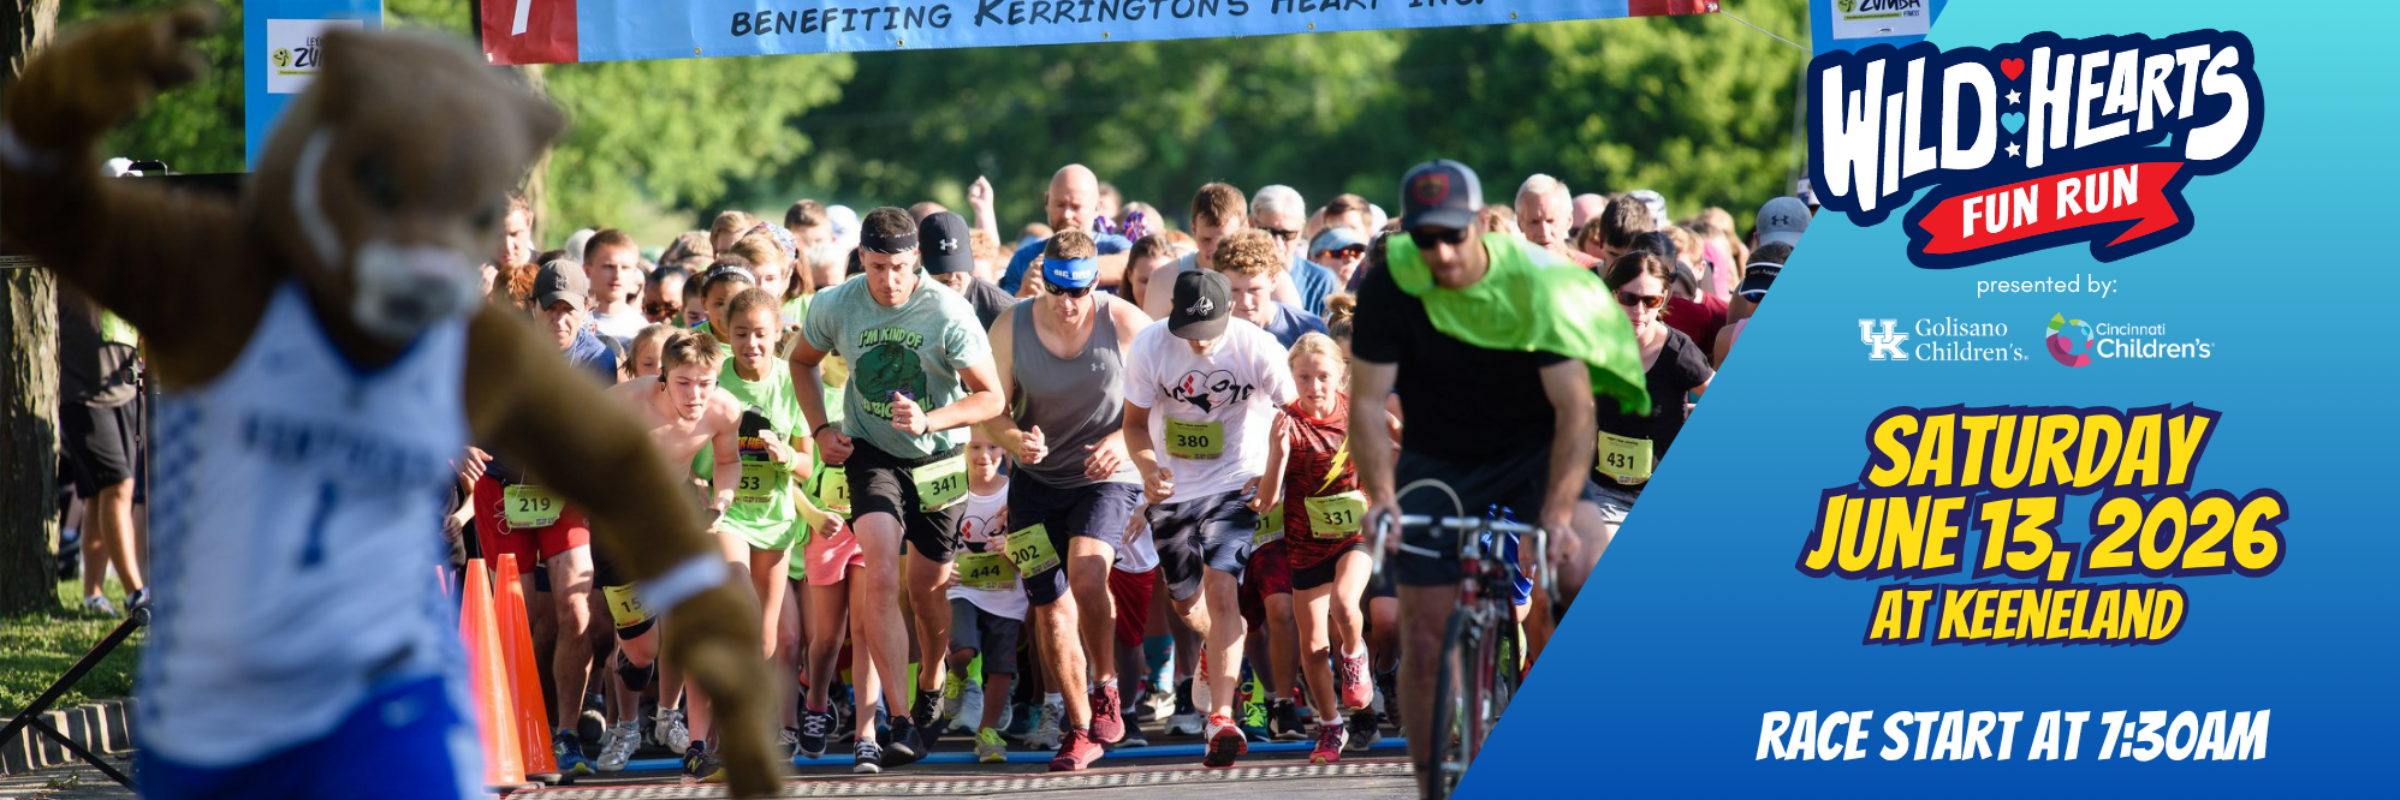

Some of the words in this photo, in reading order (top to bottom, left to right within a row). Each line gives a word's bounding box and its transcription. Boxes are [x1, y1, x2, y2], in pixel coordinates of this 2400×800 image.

[731, 6, 952, 36] BENEFITING
[974, 0, 1249, 27] KERRINGTONS
[880, 327, 906, 343] KIND
[906, 331, 923, 349] OF
[1176, 434, 1209, 448] 380
[1606, 452, 1634, 470] 431
[931, 475, 957, 496] 341
[519, 497, 550, 512] 219
[1323, 509, 1353, 526] 331
[1011, 545, 1040, 565] 202
[970, 565, 1001, 579] 444
